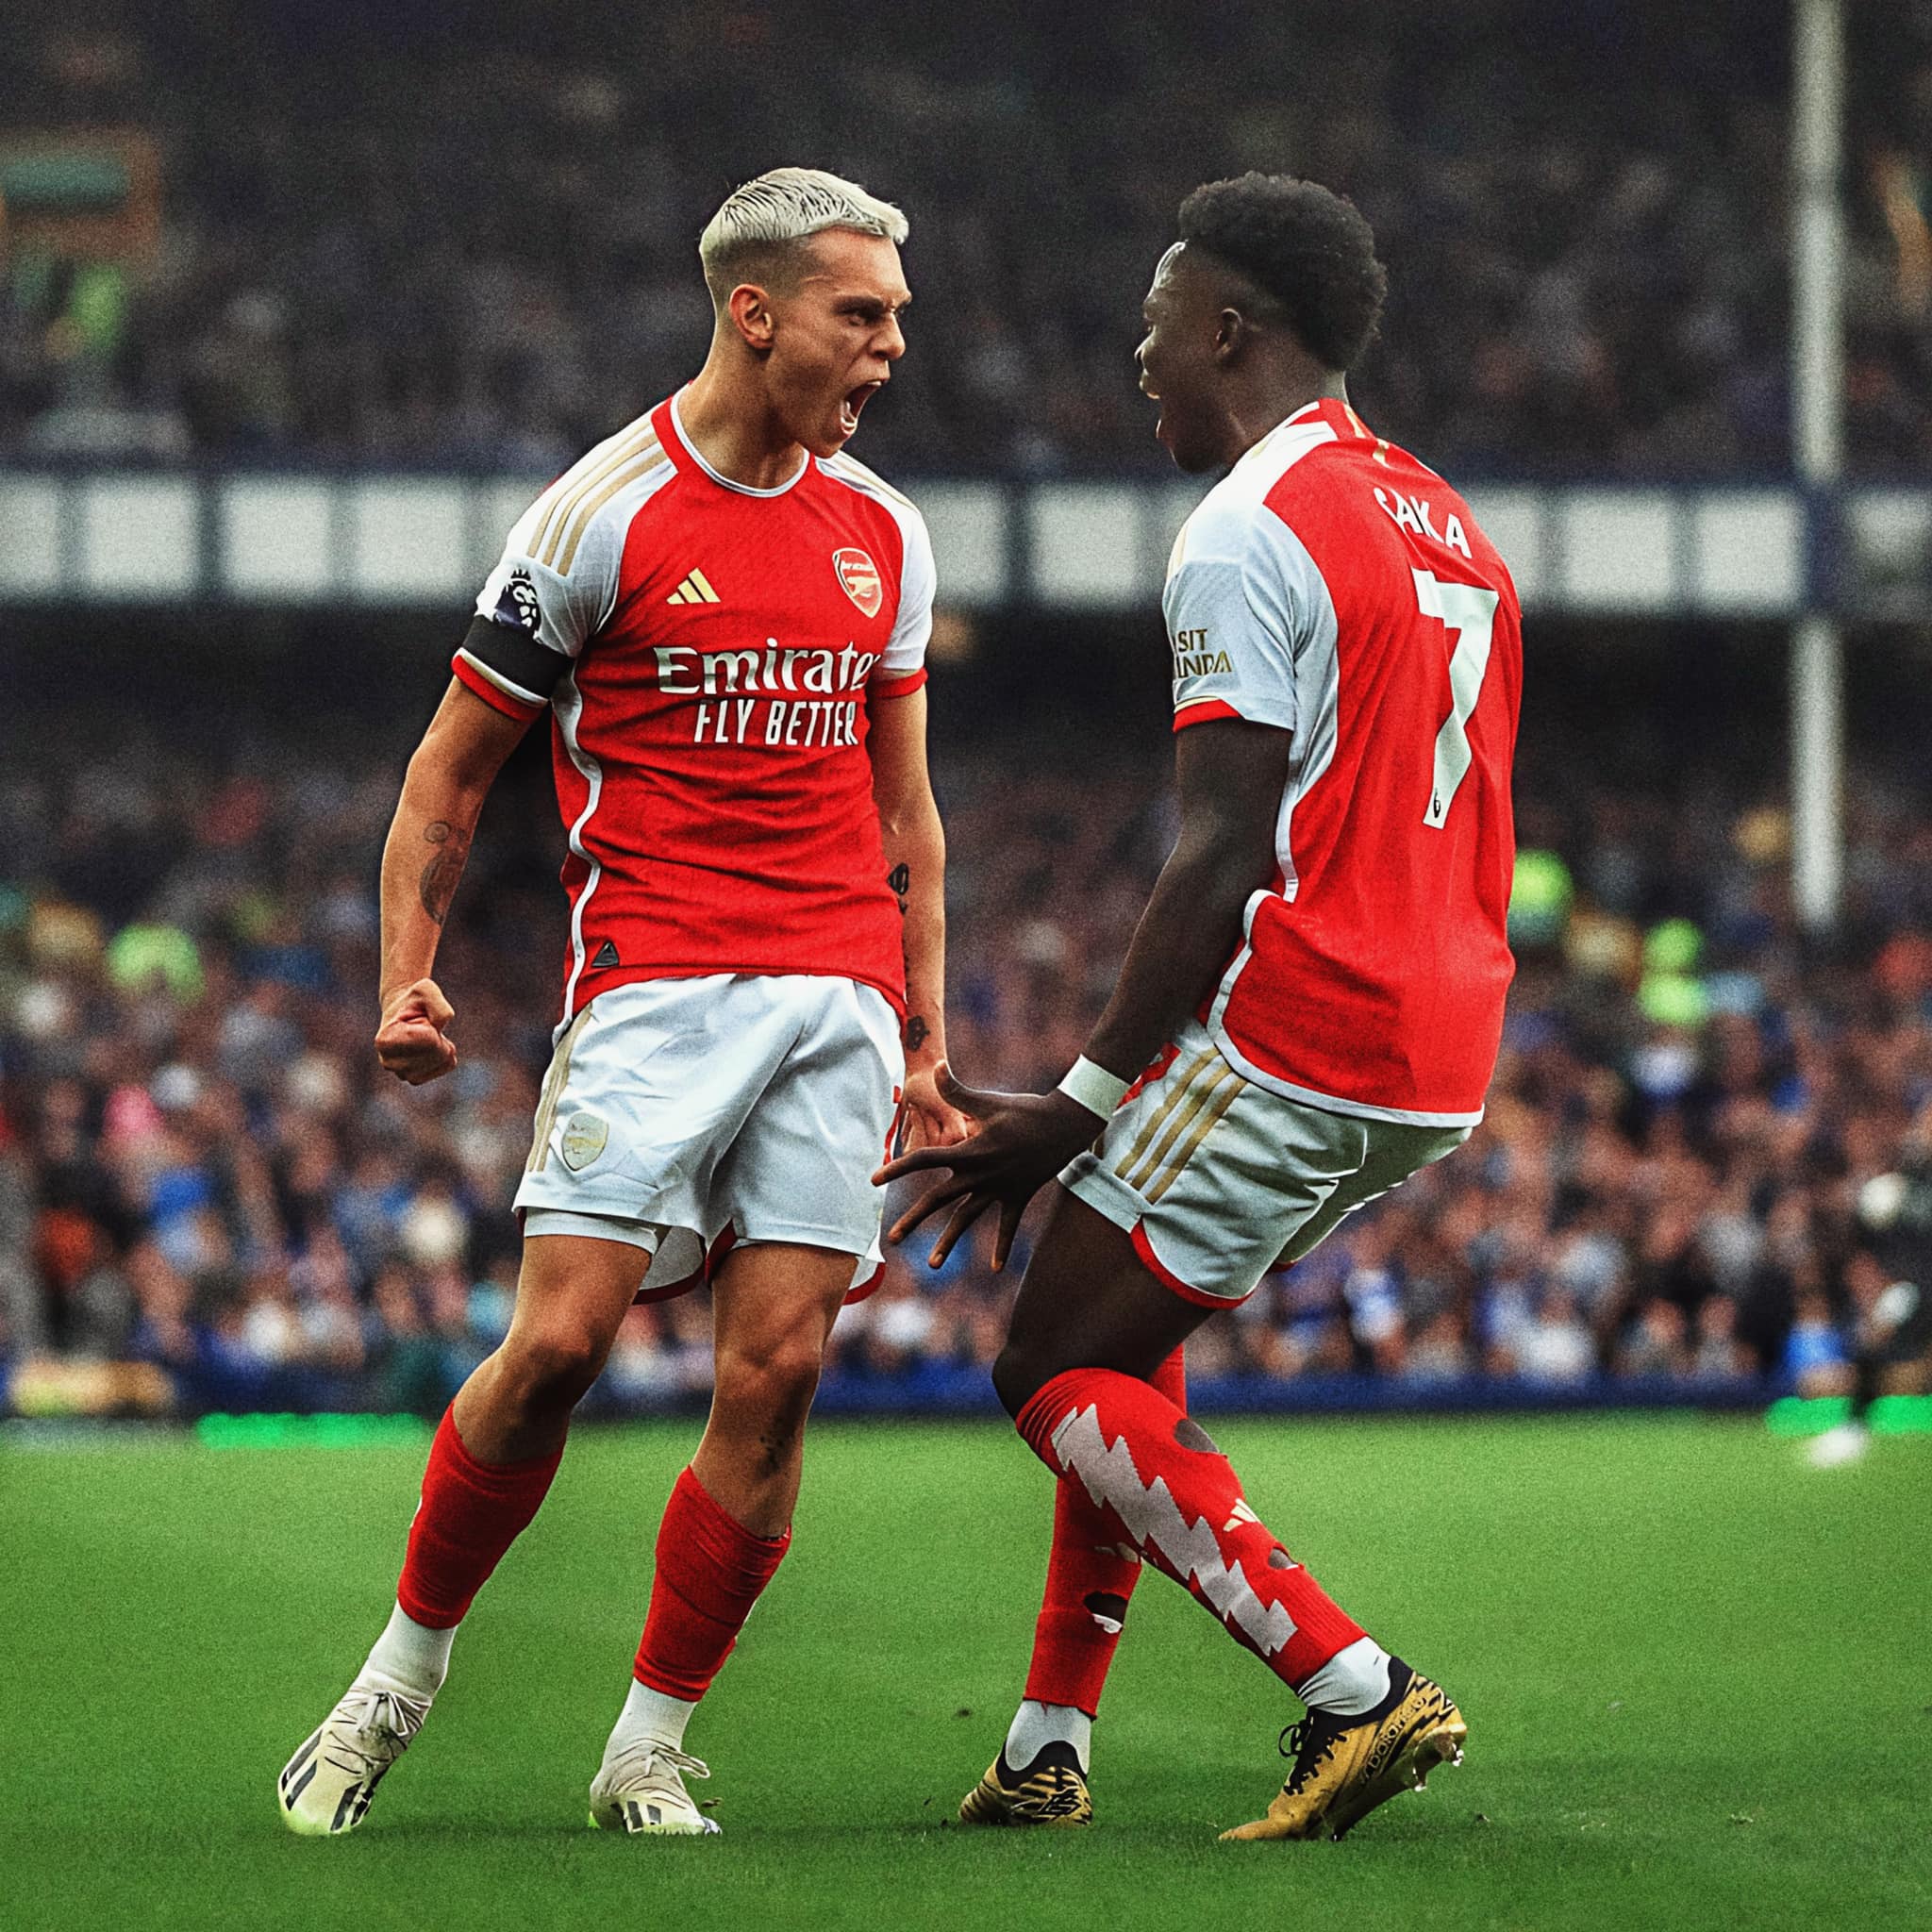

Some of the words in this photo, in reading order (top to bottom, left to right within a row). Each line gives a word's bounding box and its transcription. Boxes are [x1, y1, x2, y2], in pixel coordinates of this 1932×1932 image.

[1373, 487, 1473, 559] SAKA
[653, 638, 882, 695] Emirate
[1410, 565, 1501, 830] 7
[693, 698, 756, 744] FLY
[764, 700, 858, 748] BETTER
